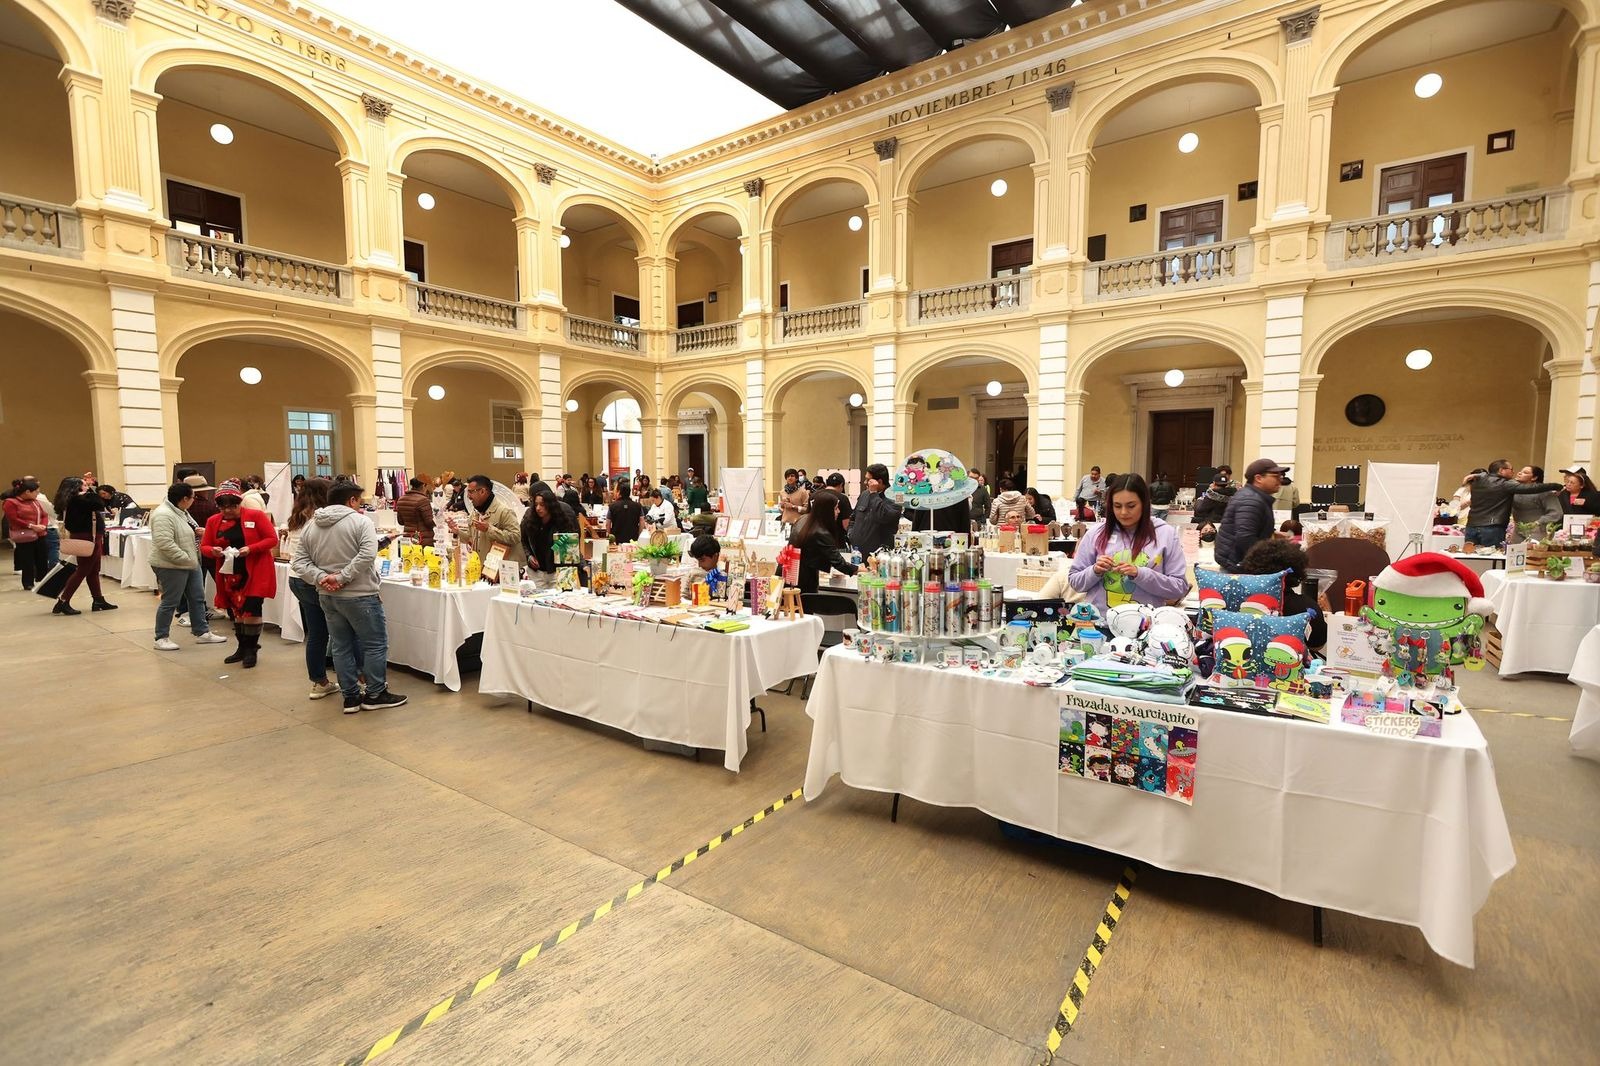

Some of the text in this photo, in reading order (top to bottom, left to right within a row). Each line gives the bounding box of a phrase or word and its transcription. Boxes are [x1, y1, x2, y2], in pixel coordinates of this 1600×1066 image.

[178, 0, 253, 33] RZO
[271, 30, 283, 46] 3
[887, 58, 1067, 127] NOVIEMBRE 7 1846
[1066, 694, 1195, 726] Frazadas Marcianito
[1365, 716, 1419, 727] STICKERS
